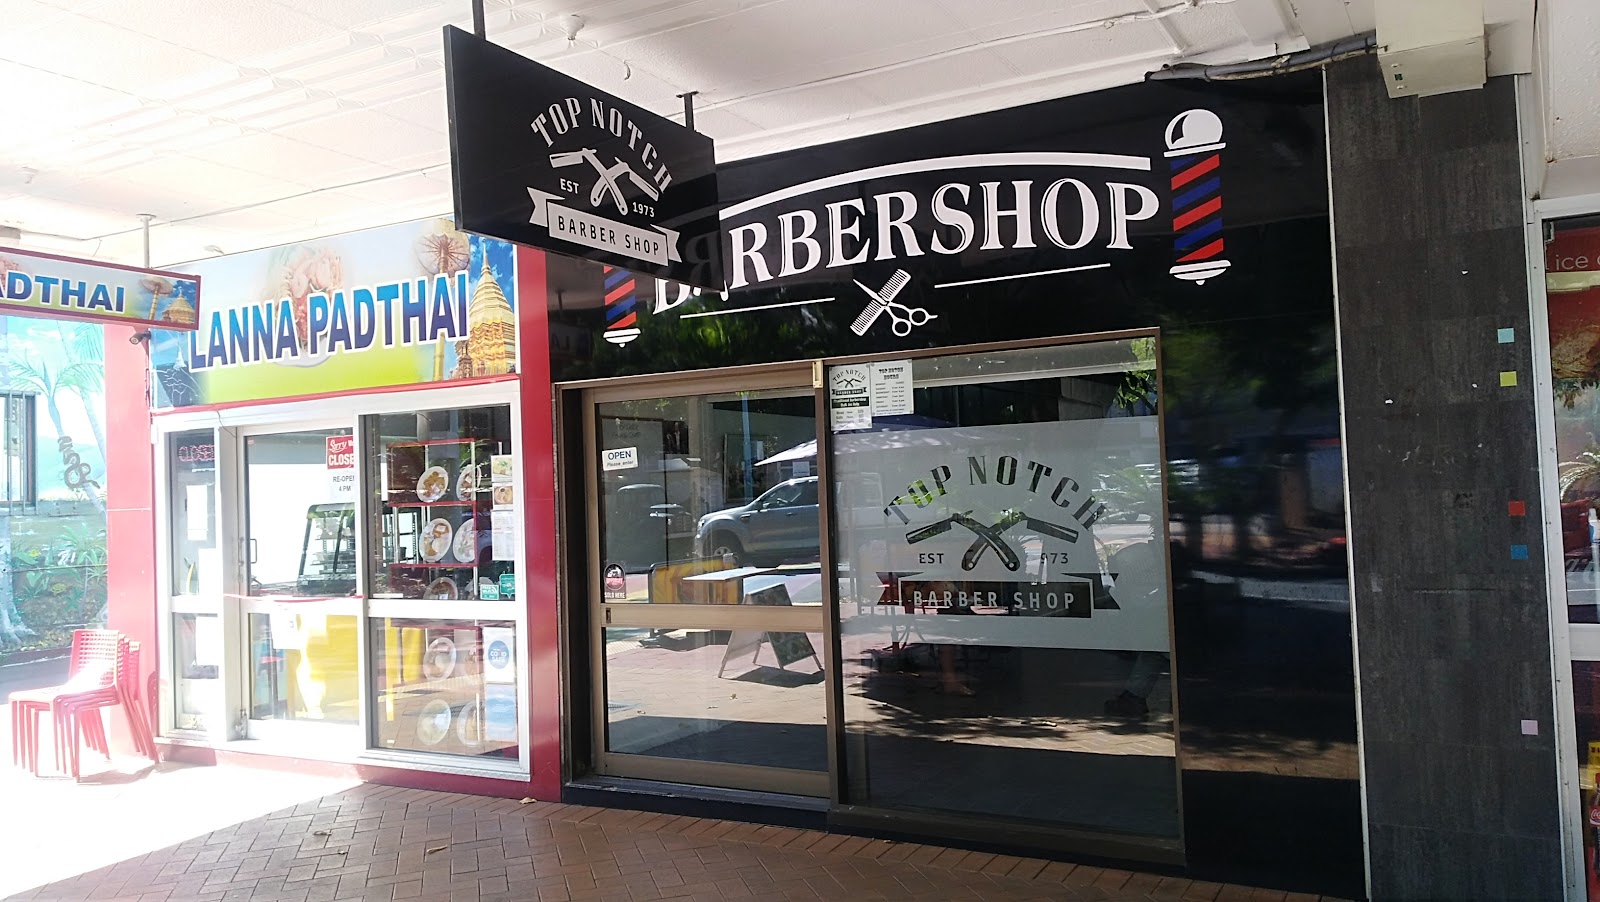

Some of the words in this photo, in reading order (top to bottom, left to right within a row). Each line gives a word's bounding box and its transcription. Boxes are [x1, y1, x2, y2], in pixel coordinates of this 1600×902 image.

[530, 97, 582, 148] TOP
[589, 97, 673, 194] NOTCH
[559, 178, 579, 194] EST
[632, 202, 655, 218] 1973
[558, 215, 616, 245] BARBER
[625, 233, 659, 256] SHOP
[652, 178, 1160, 315] BRBERSHOP
[1555, 254, 1589, 271] ice
[0, 271, 125, 313] DTHAI
[190, 299, 299, 369] LANNA
[308, 273, 468, 355] PADTHAI
[607, 450, 632, 461] OPEN
[883, 465, 952, 525] TOP
[967, 455, 1108, 531] NOTCH
[919, 553, 944, 564] EST
[1040, 553, 1069, 564] 973
[913, 591, 998, 608] BARBER
[1013, 592, 1075, 609] SHOP
